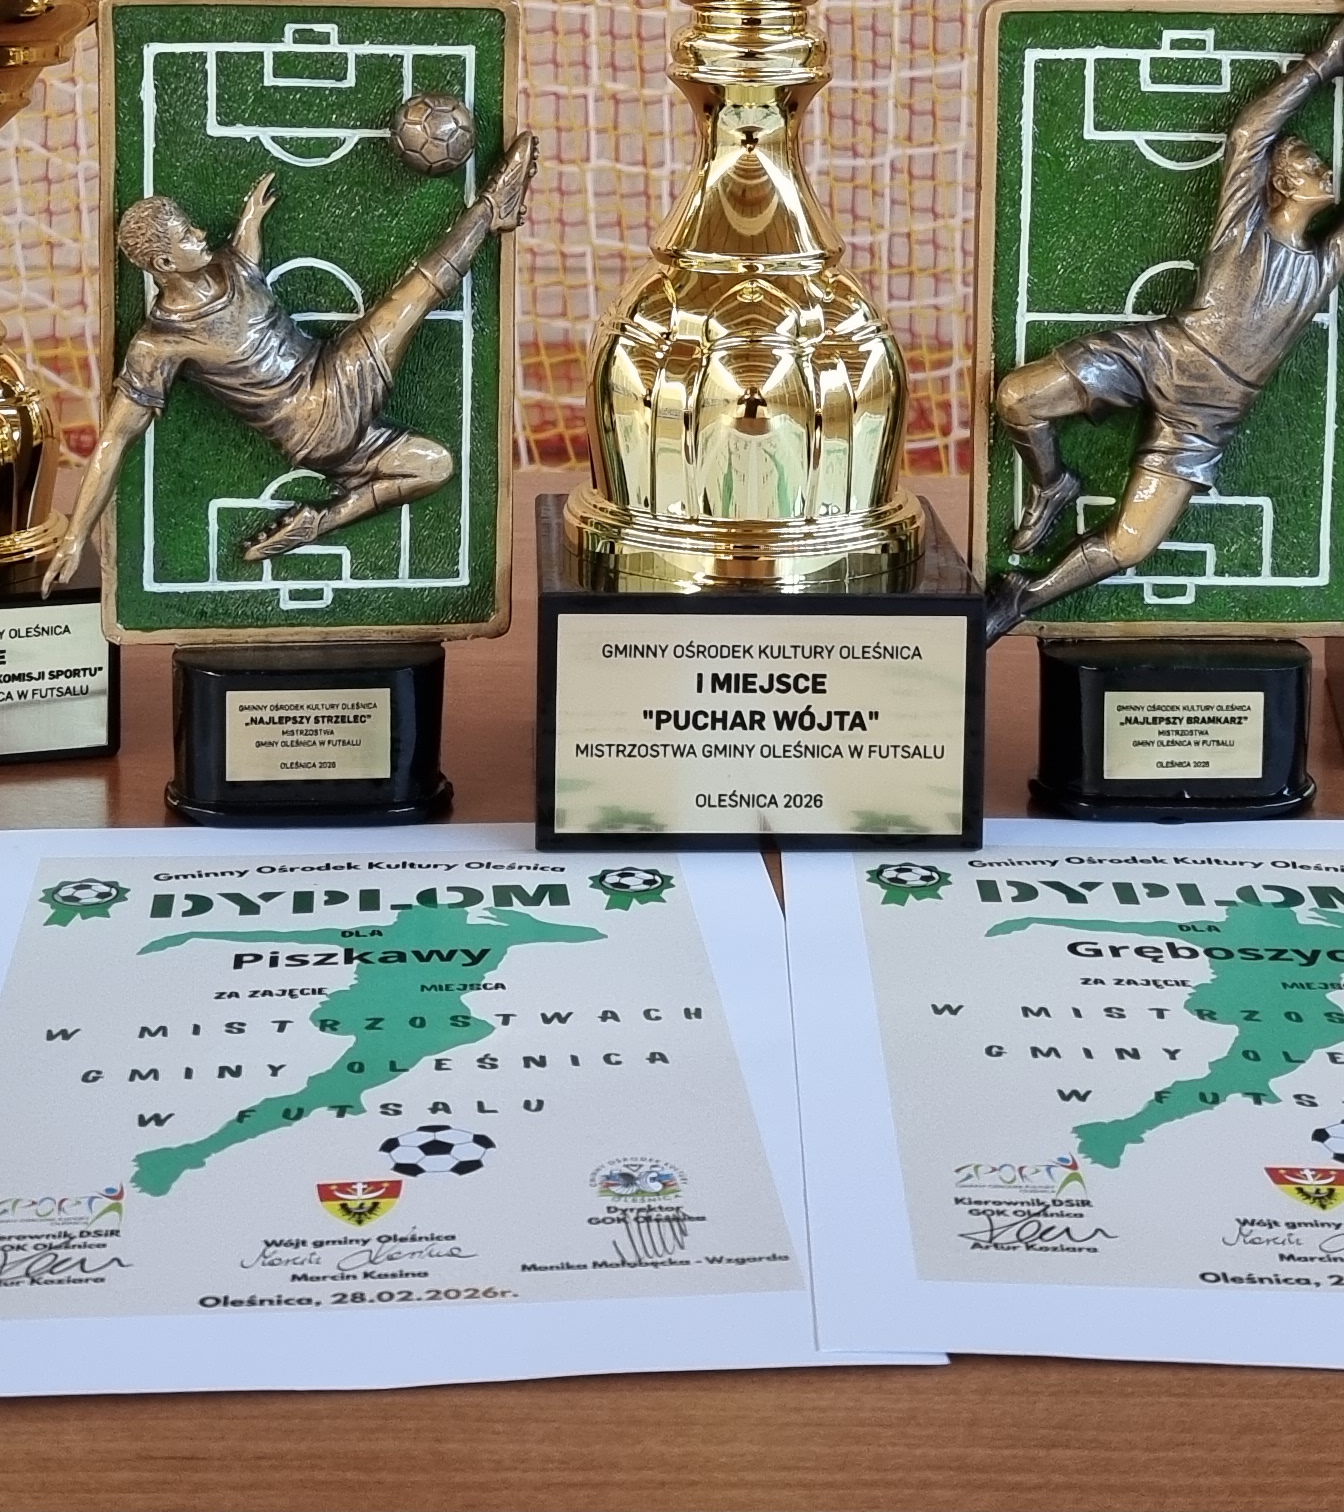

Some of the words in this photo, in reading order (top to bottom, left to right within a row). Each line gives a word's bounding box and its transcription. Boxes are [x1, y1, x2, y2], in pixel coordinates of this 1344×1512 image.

[8, 623, 71, 639] OLEŚNICA
[601, 644, 669, 659] GMINNY
[673, 641, 754, 659] OŚRODEK
[758, 645, 835, 659] KULTURY
[839, 642, 922, 660] OLEŚNICA
[16, 688, 29, 700] W
[32, 685, 89, 699] FUTSALU
[696, 673, 702, 694] I
[711, 672, 827, 694] MIEJSCE
[642, 709, 766, 731] "PUCHAR
[773, 705, 880, 731] WÓJTA"
[575, 744, 697, 759] MISTRZOSTWA
[701, 744, 755, 759] GMINY
[759, 741, 843, 759] OLEŚNICA
[845, 744, 864, 759] W
[867, 745, 945, 759] FUTSALU
[695, 790, 778, 809] OLEŚNICA
[783, 793, 823, 809] 2026
[153, 867, 249, 882] Gminny
[256, 862, 361, 874] Ośrodek
[367, 860, 459, 871] Kultury
[464, 861, 565, 873] Oleśnica
[967, 858, 1059, 868] Gminny
[1065, 855, 1168, 865] Ośrodek
[1173, 856, 1263, 868] Kultury
[149, 884, 571, 918] DYPLOM
[232, 946, 492, 970] Piszkawy
[214, 991, 240, 999] ZA
[248, 988, 328, 999] ZAJĘCIE
[420, 982, 506, 992] MIEJSCA
[930, 1003, 964, 1016] W
[46, 1028, 81, 1041] W
[138, 1007, 702, 1038] MISTRZOSTWACH
[984, 1044, 1181, 1060] GMINY
[81, 1063, 287, 1083] GMINY
[346, 1051, 670, 1074] OLEŚNICA
[1057, 1088, 1092, 1103] W
[138, 1113, 175, 1127] W
[236, 1099, 544, 1123] FUTSALU
[1199, 1271, 1321, 1288] Oleśnica,
[198, 1295, 321, 1308] Oleśnica,
[330, 1288, 519, 1305] 28.02.2026r.
